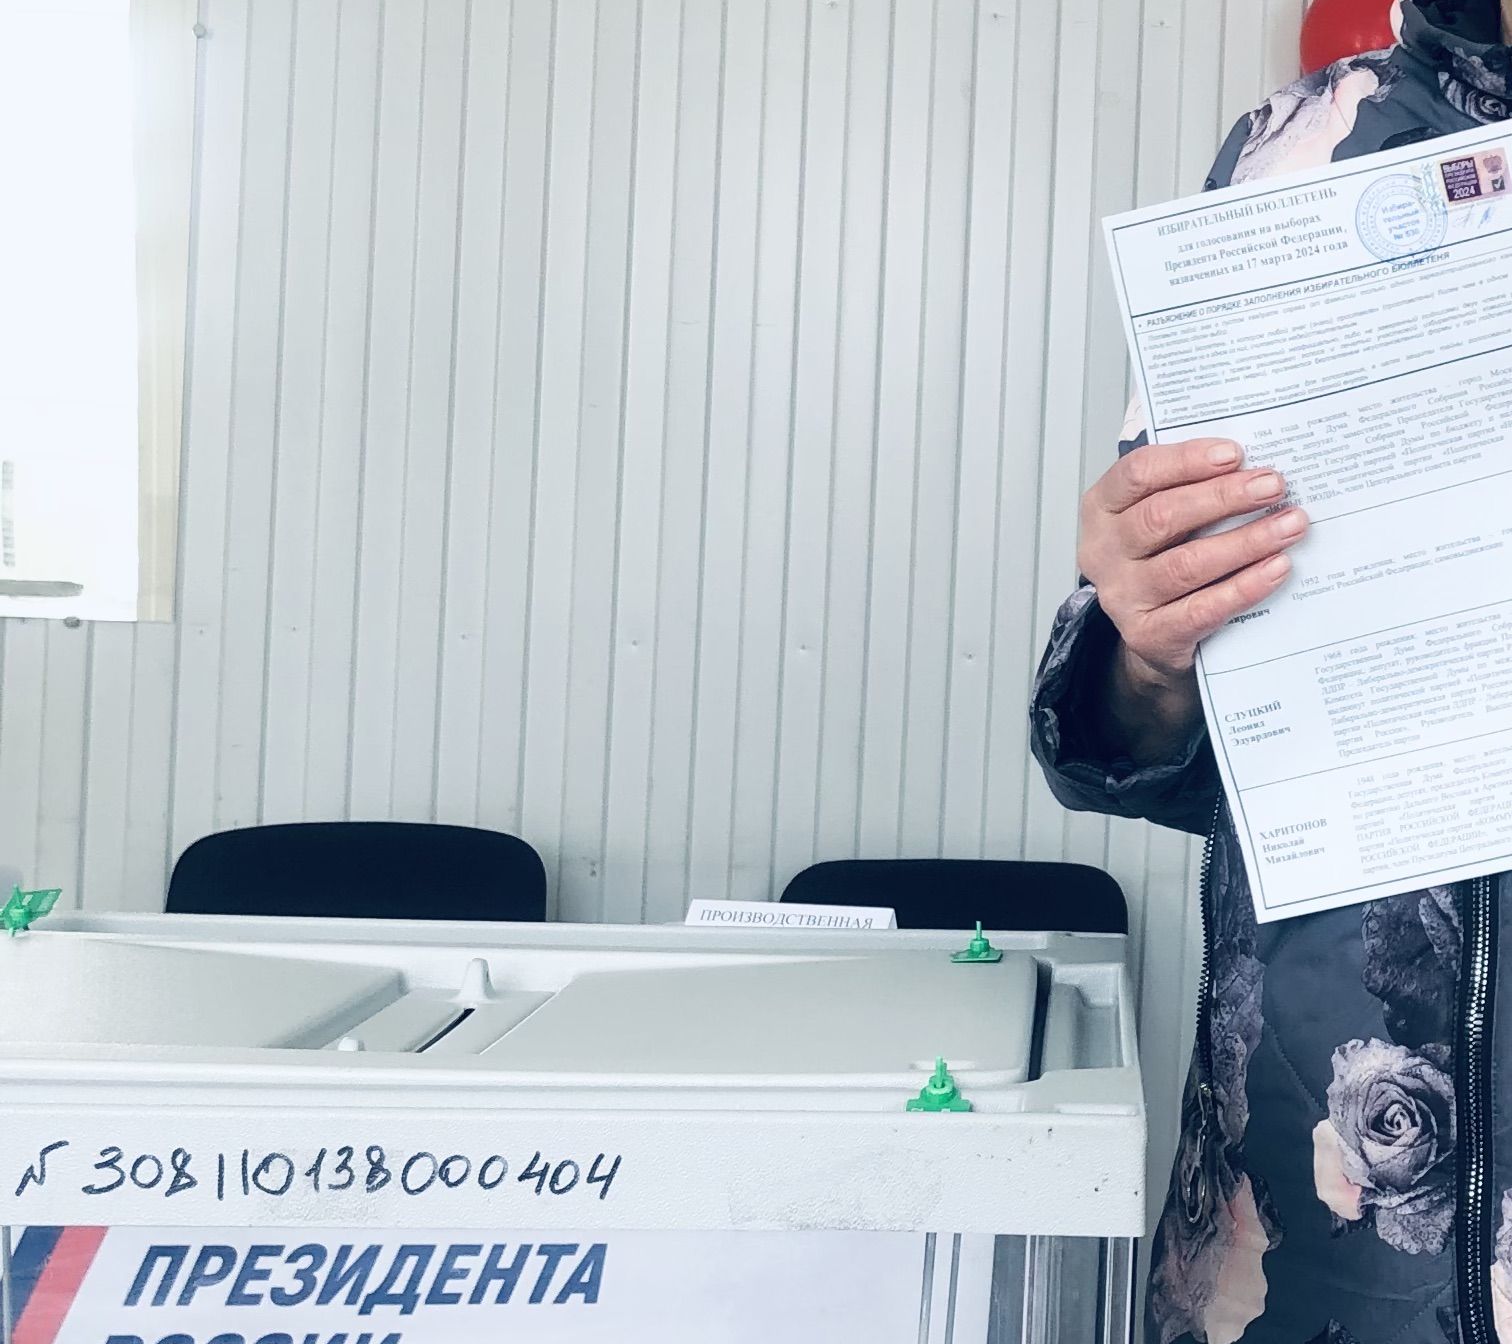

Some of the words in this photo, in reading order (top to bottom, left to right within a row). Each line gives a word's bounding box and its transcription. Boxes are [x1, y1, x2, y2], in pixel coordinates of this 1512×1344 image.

[1451, 184, 1476, 200] 2024
[1155, 203, 1254, 237] ИЗБИРАТЕЛЬНЫЙ
[1255, 185, 1338, 215] БЮЛЛЕТЕНЬ
[1176, 242, 1194, 254] для
[1194, 227, 1257, 250] голосования
[1258, 224, 1272, 235] на
[1273, 210, 1322, 233] выборах
[1163, 250, 1218, 274] Президента
[1218, 236, 1278, 260] Российской
[1279, 221, 1348, 248] Федерации,
[1168, 265, 1230, 287] назначенных
[1231, 262, 1244, 273] на
[1246, 257, 1258, 270] 17
[1260, 251, 1293, 269] марта
[1293, 244, 1321, 259] 2024
[1322, 239, 1349, 255] года
[1145, 308, 1198, 329] РАЗЪЯСНЕНИЕ
[1198, 307, 1205, 316] О
[1204, 298, 1243, 316] ПОРЯДКЕ
[1242, 285, 1303, 308] ЗАПОЛНЕНИЯ
[1302, 265, 1390, 295] ИЗБИРАТЕЛЬНОГО
[1389, 249, 1452, 274] БЮЛЛЕТЕНЯ
[1223, 699, 1282, 723] СЛУЦКИЙ
[1227, 719, 1265, 735] Леонид
[1230, 725, 1292, 748] Эдуардович
[1258, 817, 1328, 840] ХАРИТОНОВ
[1261, 835, 1305, 853] Николай
[1264, 844, 1326, 866] Михайлович
[700, 908, 874, 929] ПРОИЗВОДСТВЕННАЯ
[123, 1242, 609, 1316] ПРЕЗИДЕНТА
